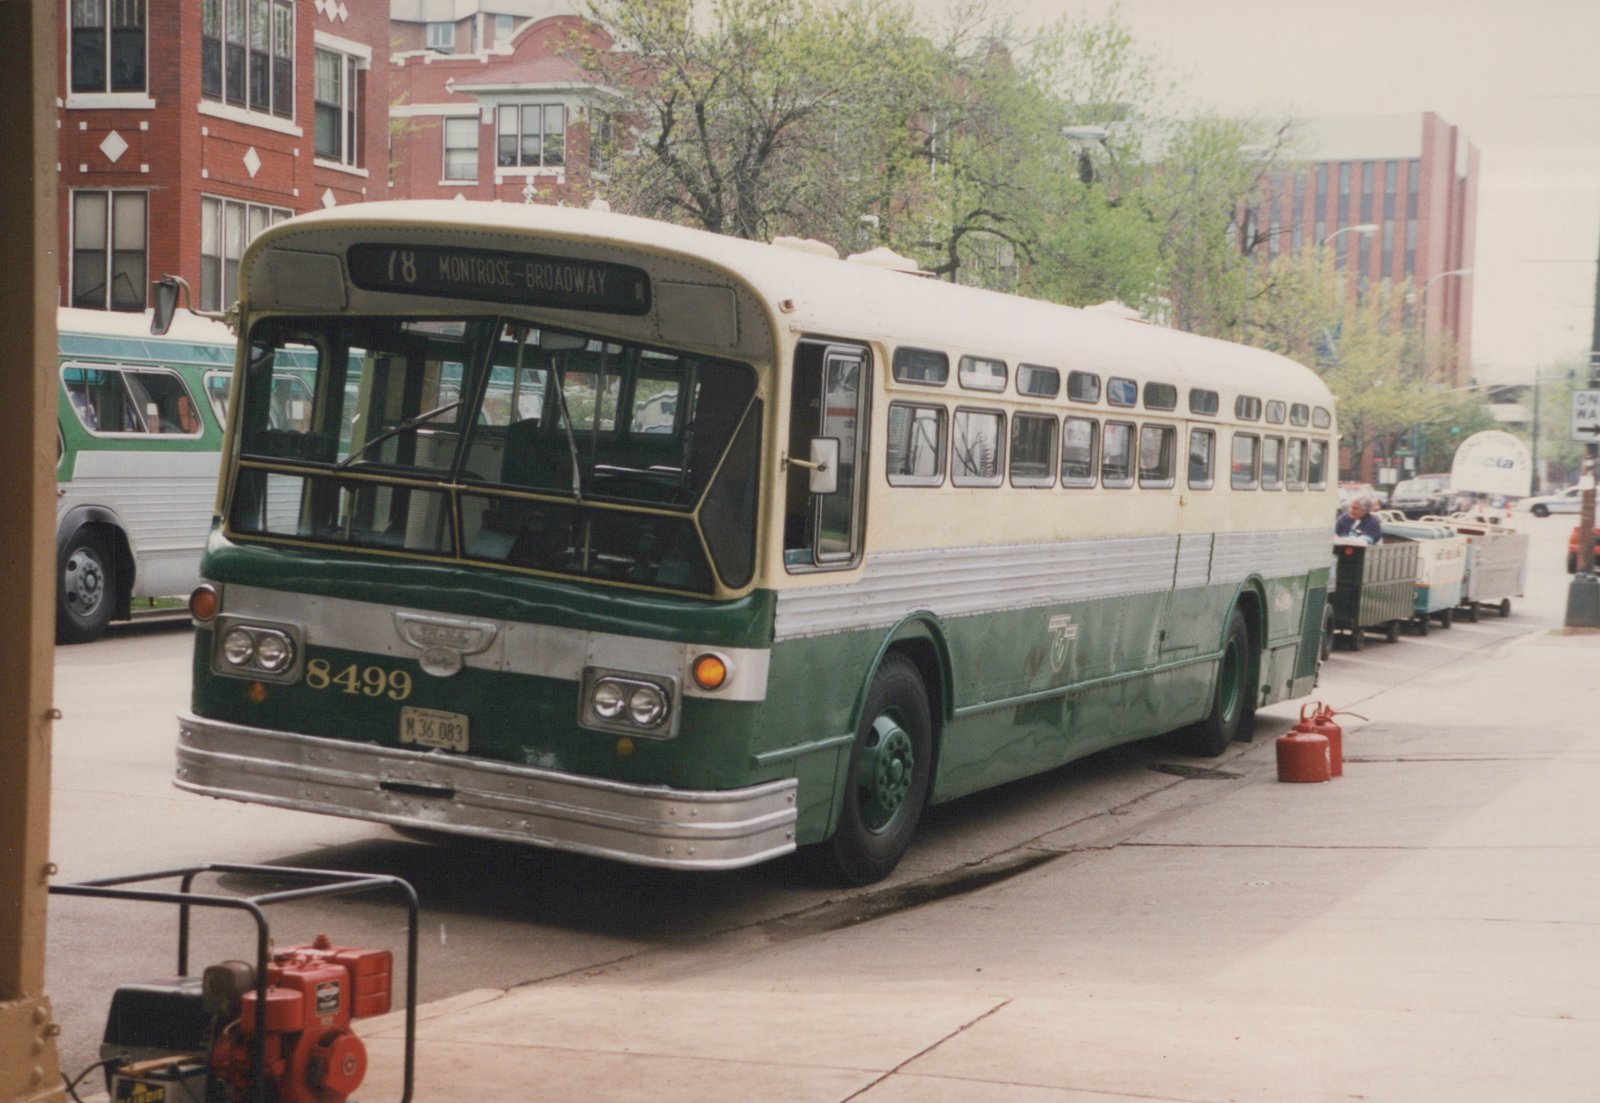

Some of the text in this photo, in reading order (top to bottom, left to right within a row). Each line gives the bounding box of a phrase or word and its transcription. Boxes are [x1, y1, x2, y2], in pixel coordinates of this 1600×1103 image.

[388, 250, 607, 295] 78 MONTROSE-BROADWAY
[1577, 393, 1599, 406] ON
[1576, 409, 1598, 419] WA
[306, 658, 413, 701] 8499
